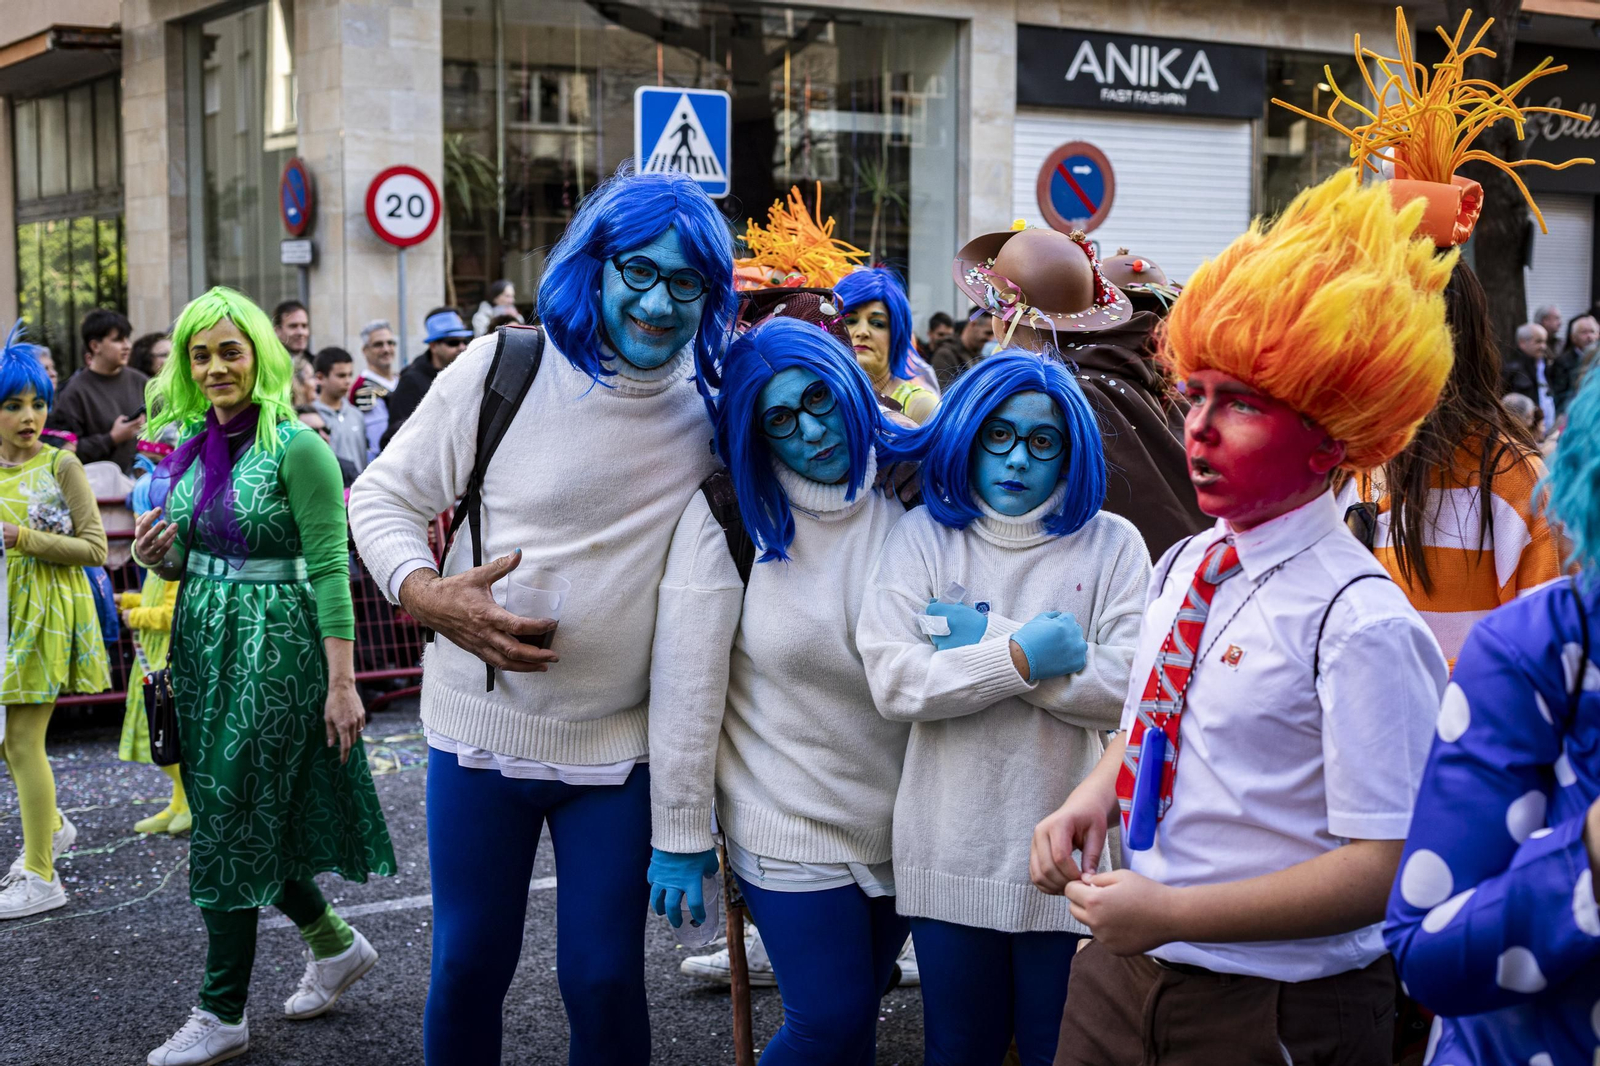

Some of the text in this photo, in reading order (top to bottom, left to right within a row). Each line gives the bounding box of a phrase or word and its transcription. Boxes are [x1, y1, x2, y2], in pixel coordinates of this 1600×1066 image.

[1065, 40, 1219, 92] ANIKA
[1100, 88, 1133, 103] FAST
[386, 194, 425, 218] 20
